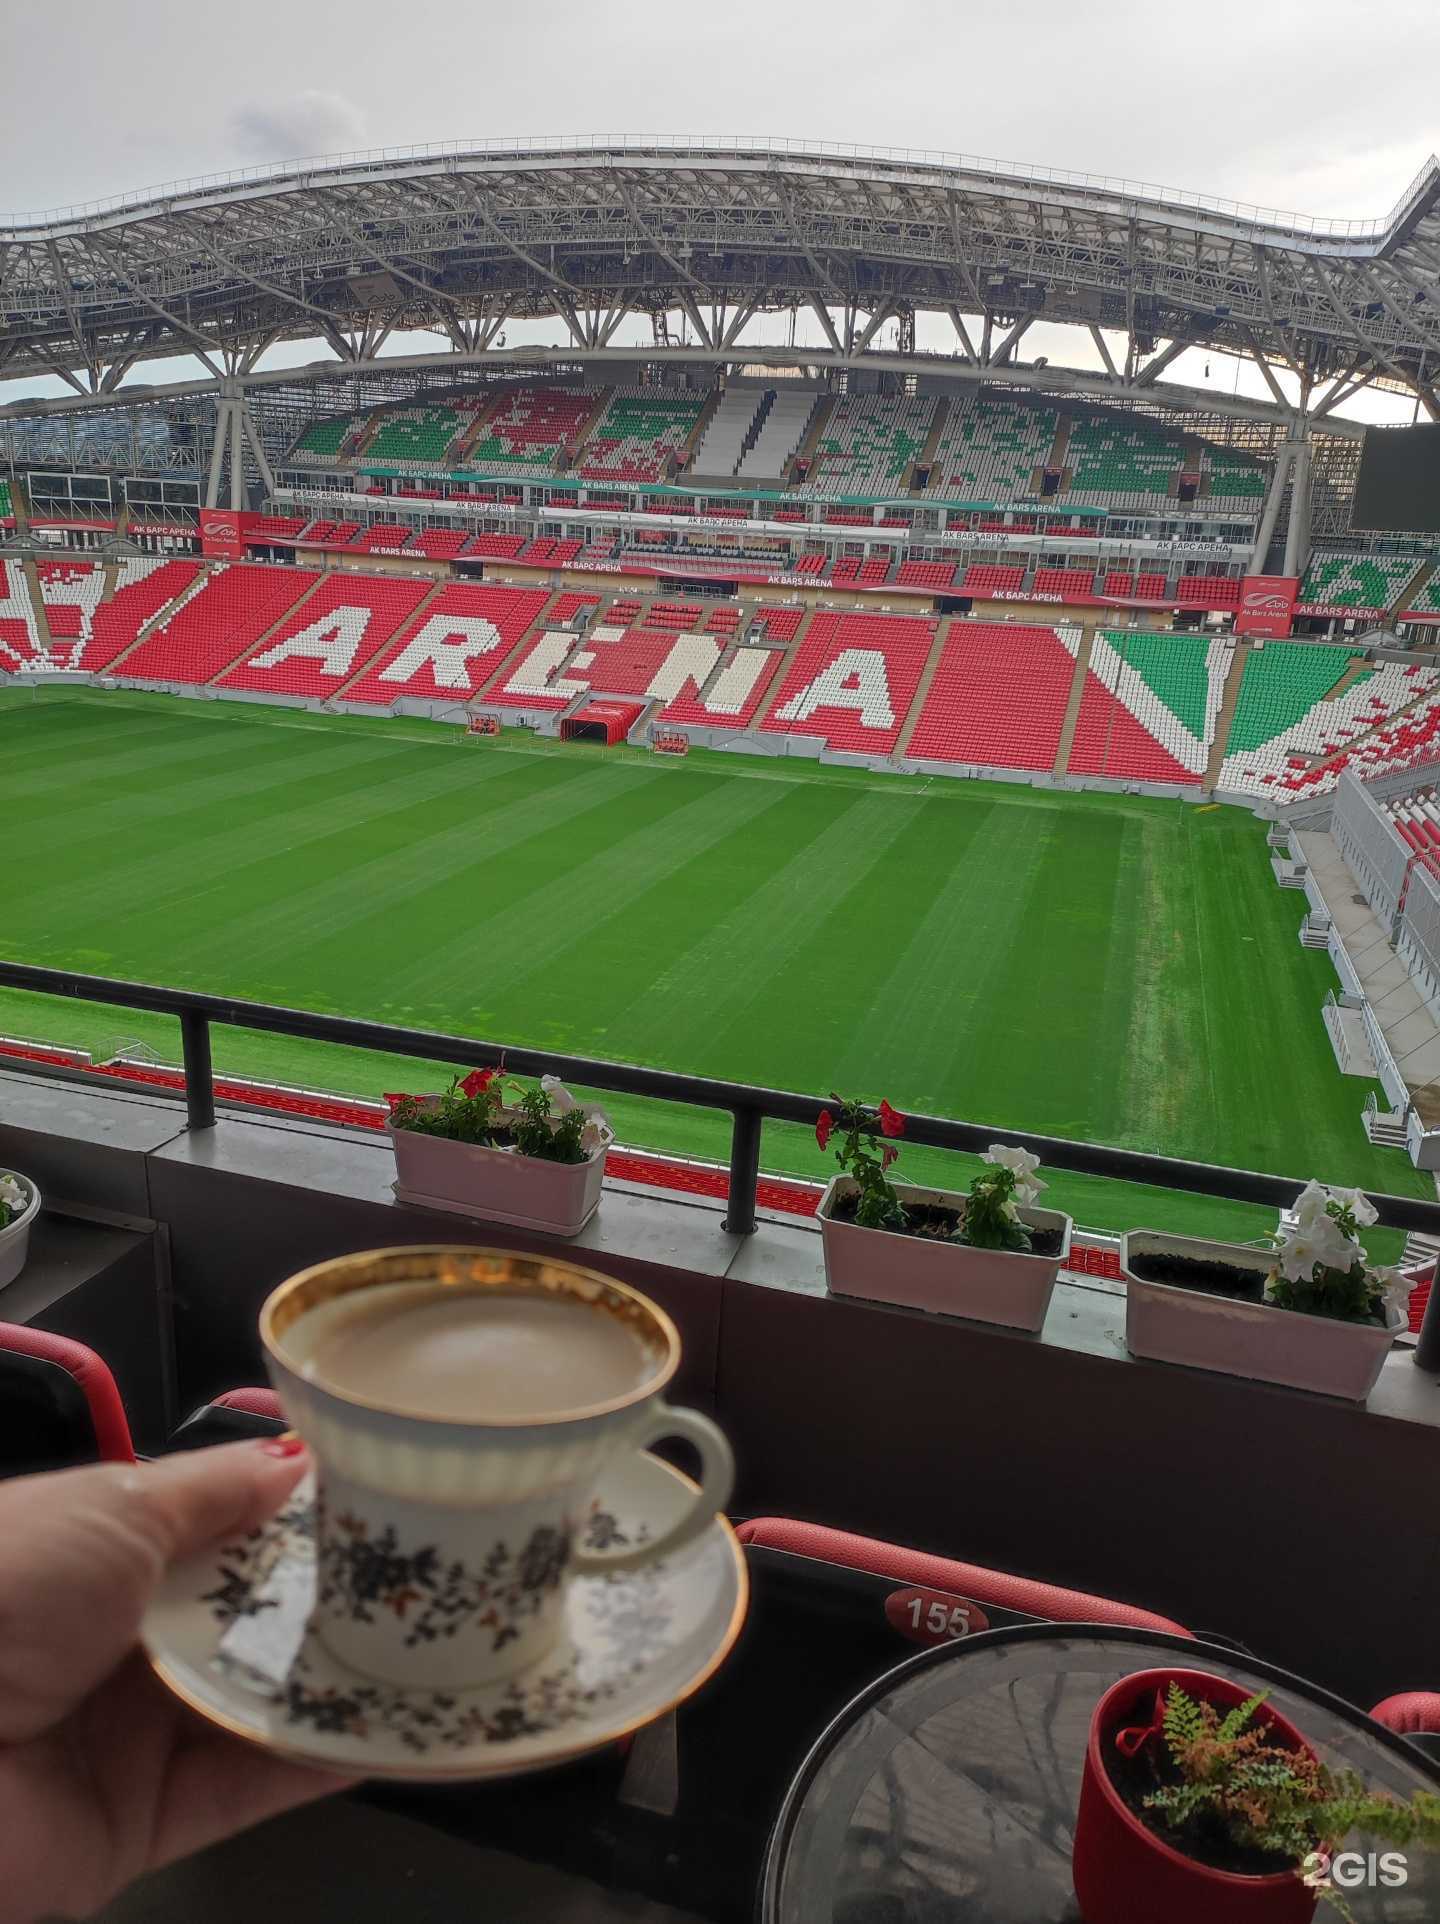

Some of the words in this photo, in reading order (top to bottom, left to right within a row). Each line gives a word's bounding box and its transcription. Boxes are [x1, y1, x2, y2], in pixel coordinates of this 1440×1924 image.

[614, 483, 640, 491] ARENA
[1031, 504, 1061, 513] ARENA
[401, 548, 426, 558] ARENA
[780, 576, 803, 586] BARS
[804, 578, 833, 588] ARENA
[1315, 606, 1343, 617] BARS
[1343, 607, 1379, 619] ARENA
[247, 605, 895, 730] ARENA
[907, 1598, 970, 1638] 155
